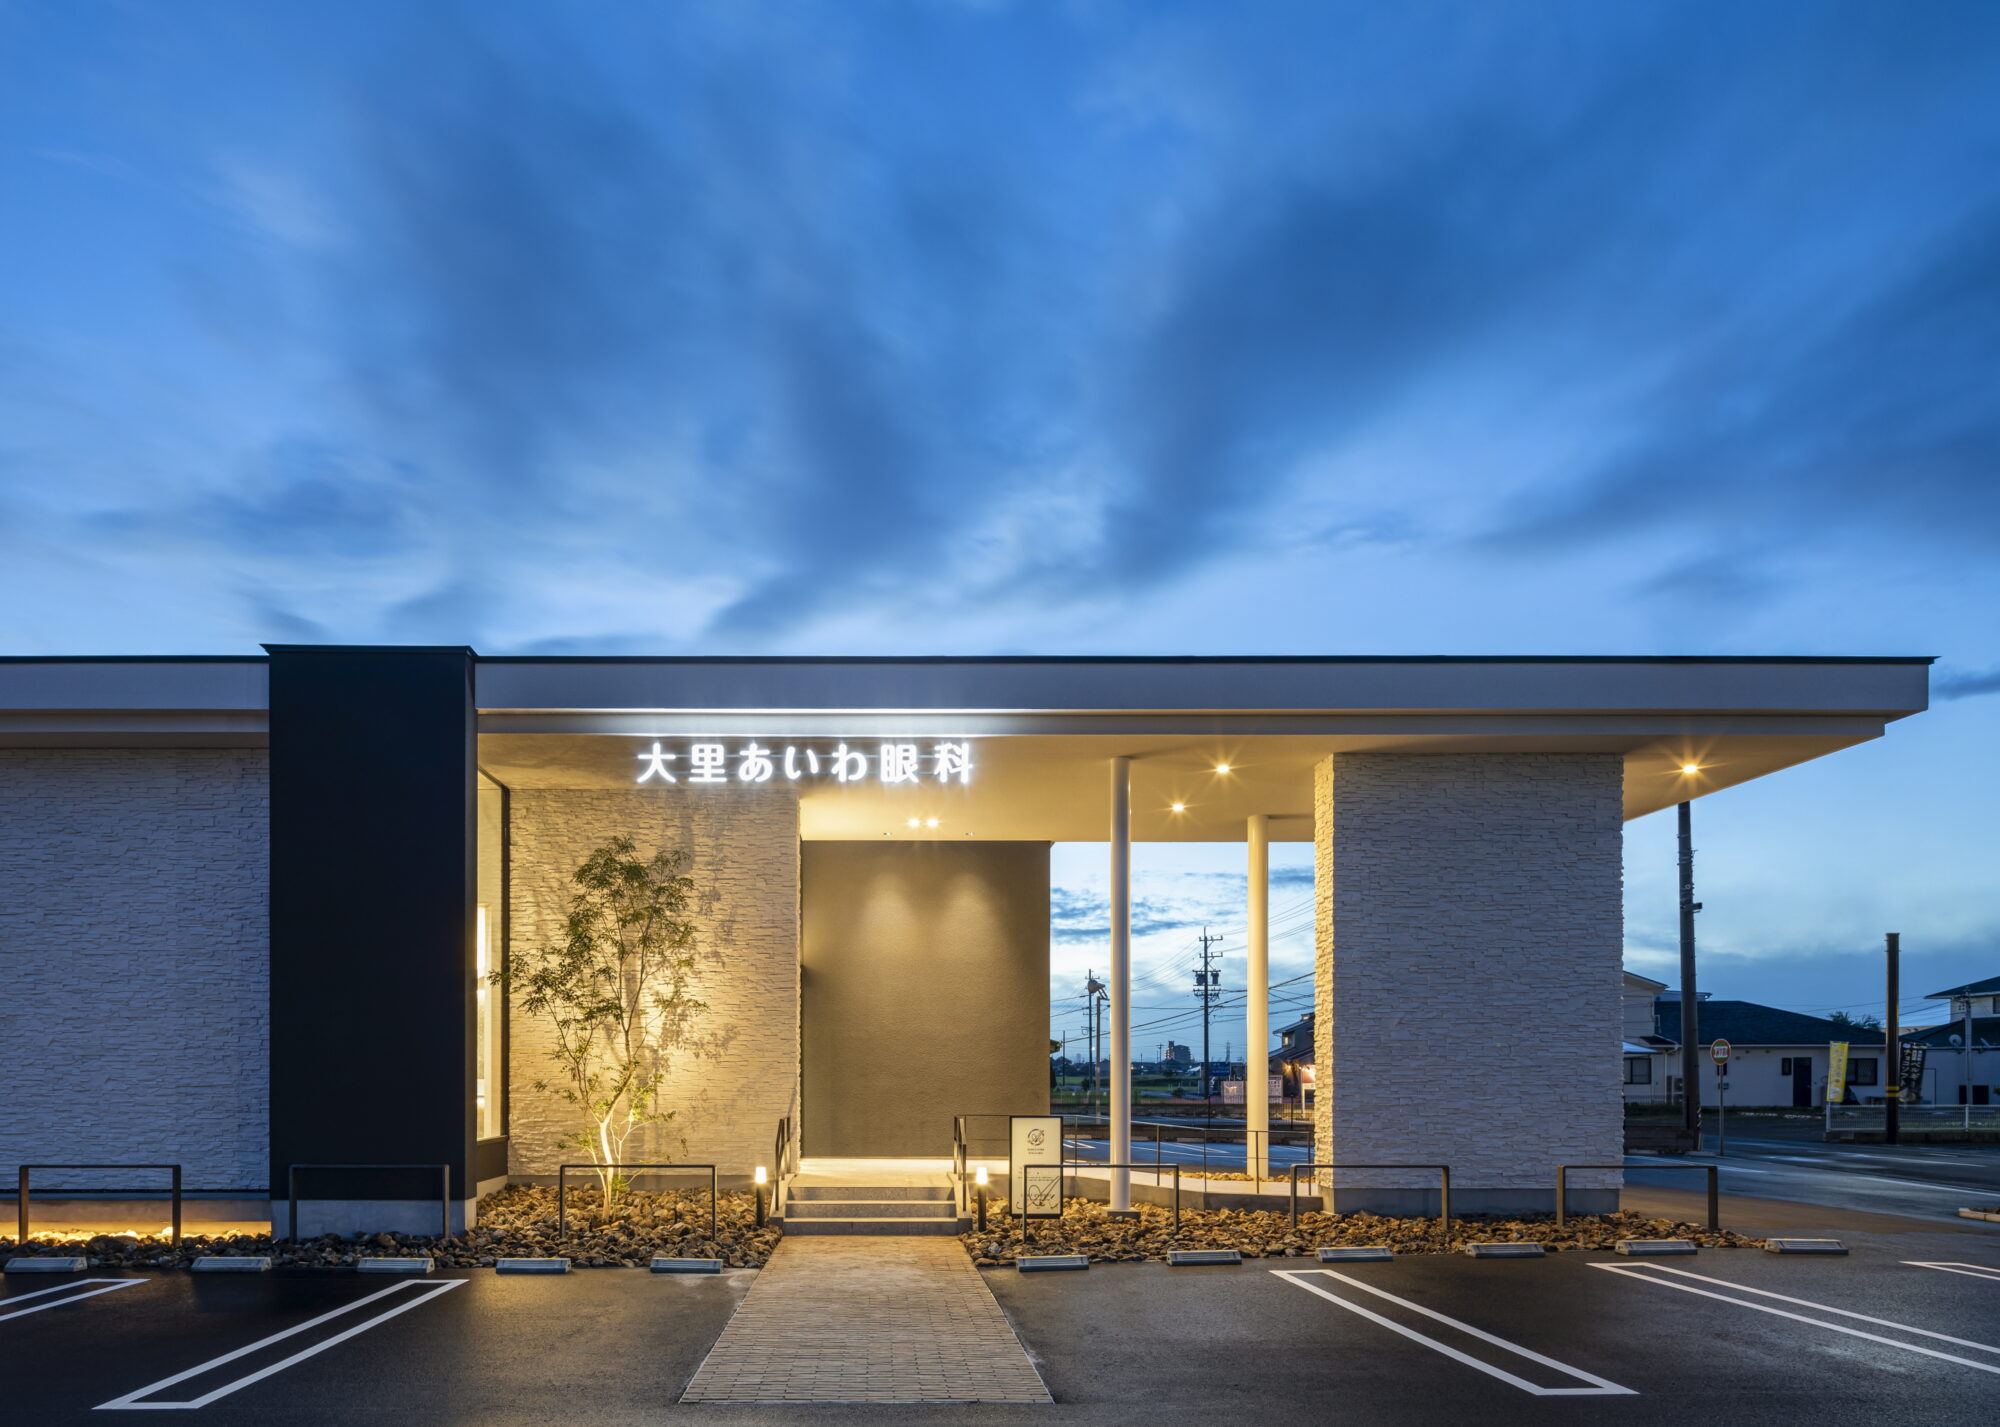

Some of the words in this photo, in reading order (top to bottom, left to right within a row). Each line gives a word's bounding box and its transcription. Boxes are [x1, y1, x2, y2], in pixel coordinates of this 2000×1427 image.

[637, 743, 973, 783] 大里あいわ眼科
